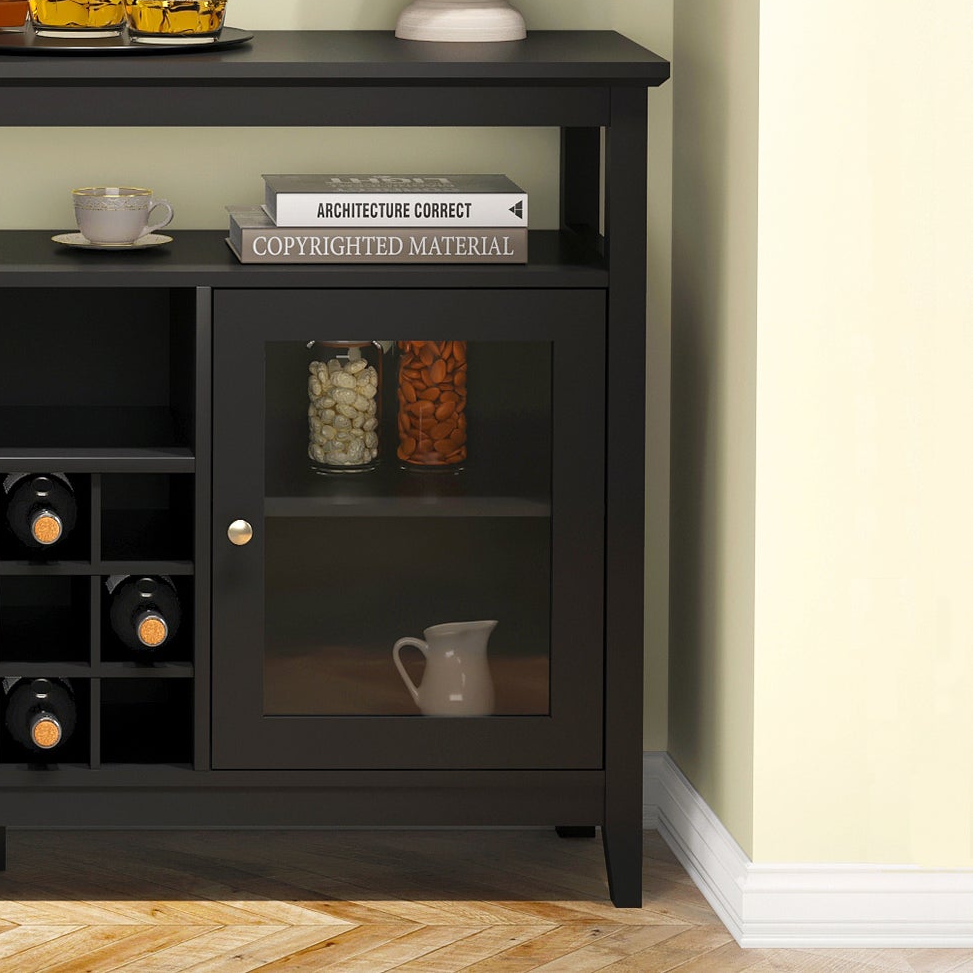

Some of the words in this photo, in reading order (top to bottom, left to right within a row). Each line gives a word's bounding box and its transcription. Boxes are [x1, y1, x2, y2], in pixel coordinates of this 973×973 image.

[317, 202, 411, 218] ARCHITECTURE
[414, 202, 472, 218] CORRECT
[252, 235, 404, 256] COPYRIGHTED
[408, 235, 515, 256] MATERIAL
